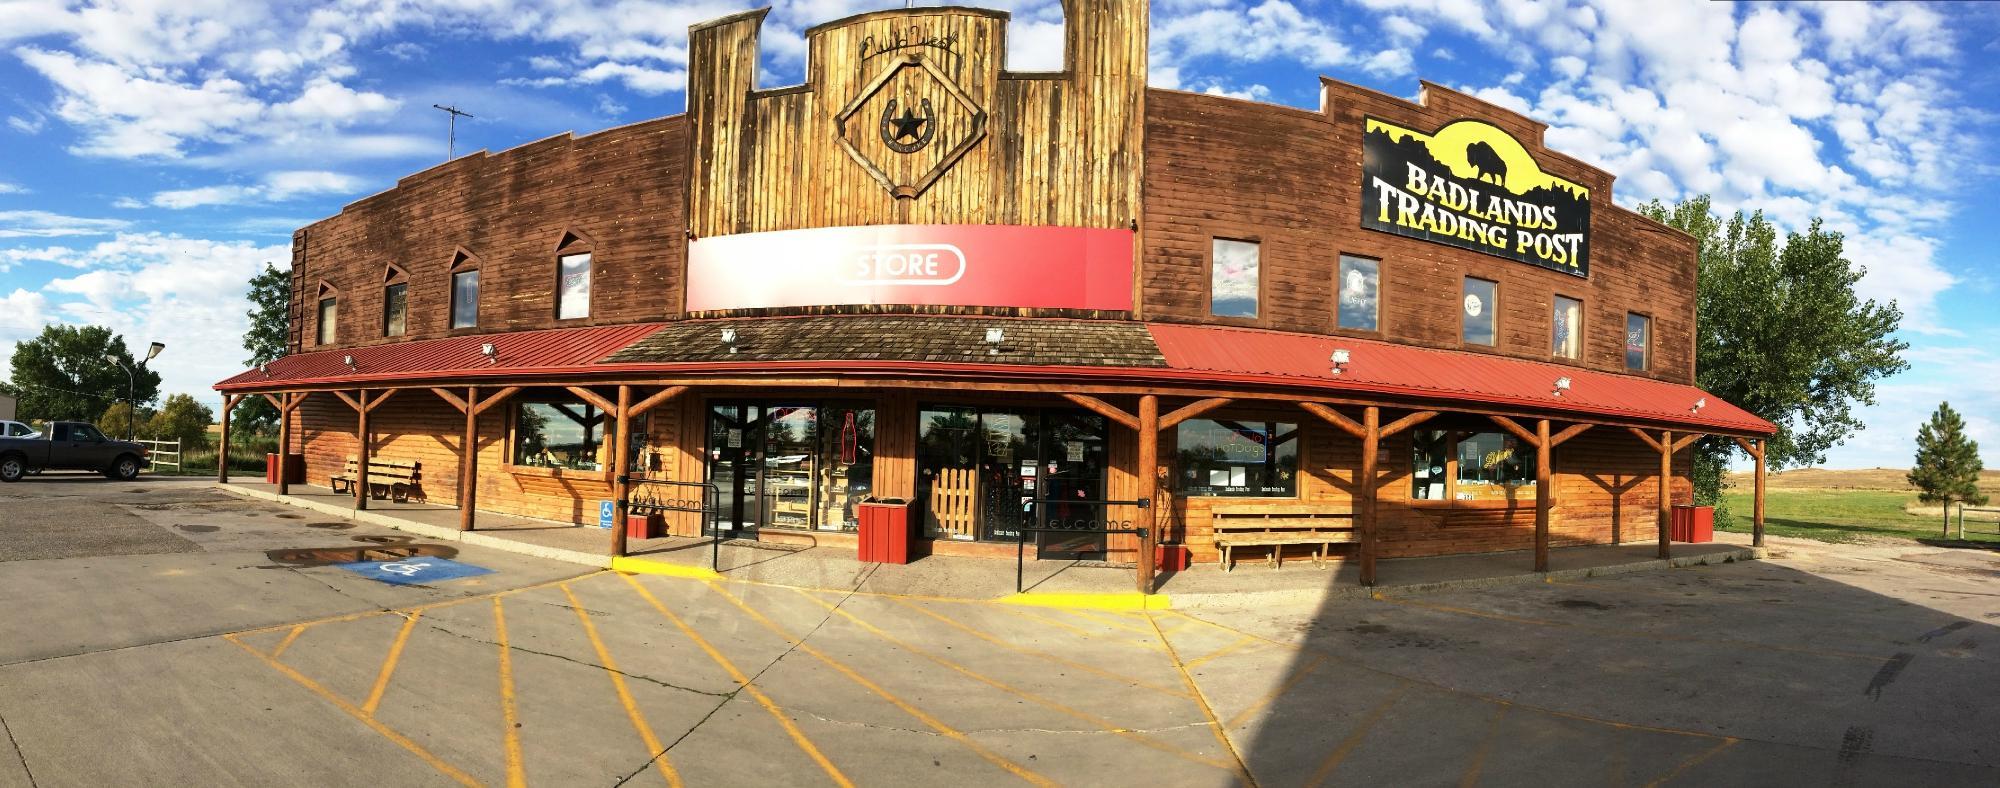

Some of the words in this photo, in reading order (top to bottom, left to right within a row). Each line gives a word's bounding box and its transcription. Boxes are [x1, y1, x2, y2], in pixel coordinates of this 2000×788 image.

[1373, 176, 1507, 249] TRADING
[1516, 230, 1583, 268] POST
[1406, 161, 1557, 230] BADLANDS
[857, 253, 938, 276] STORE
